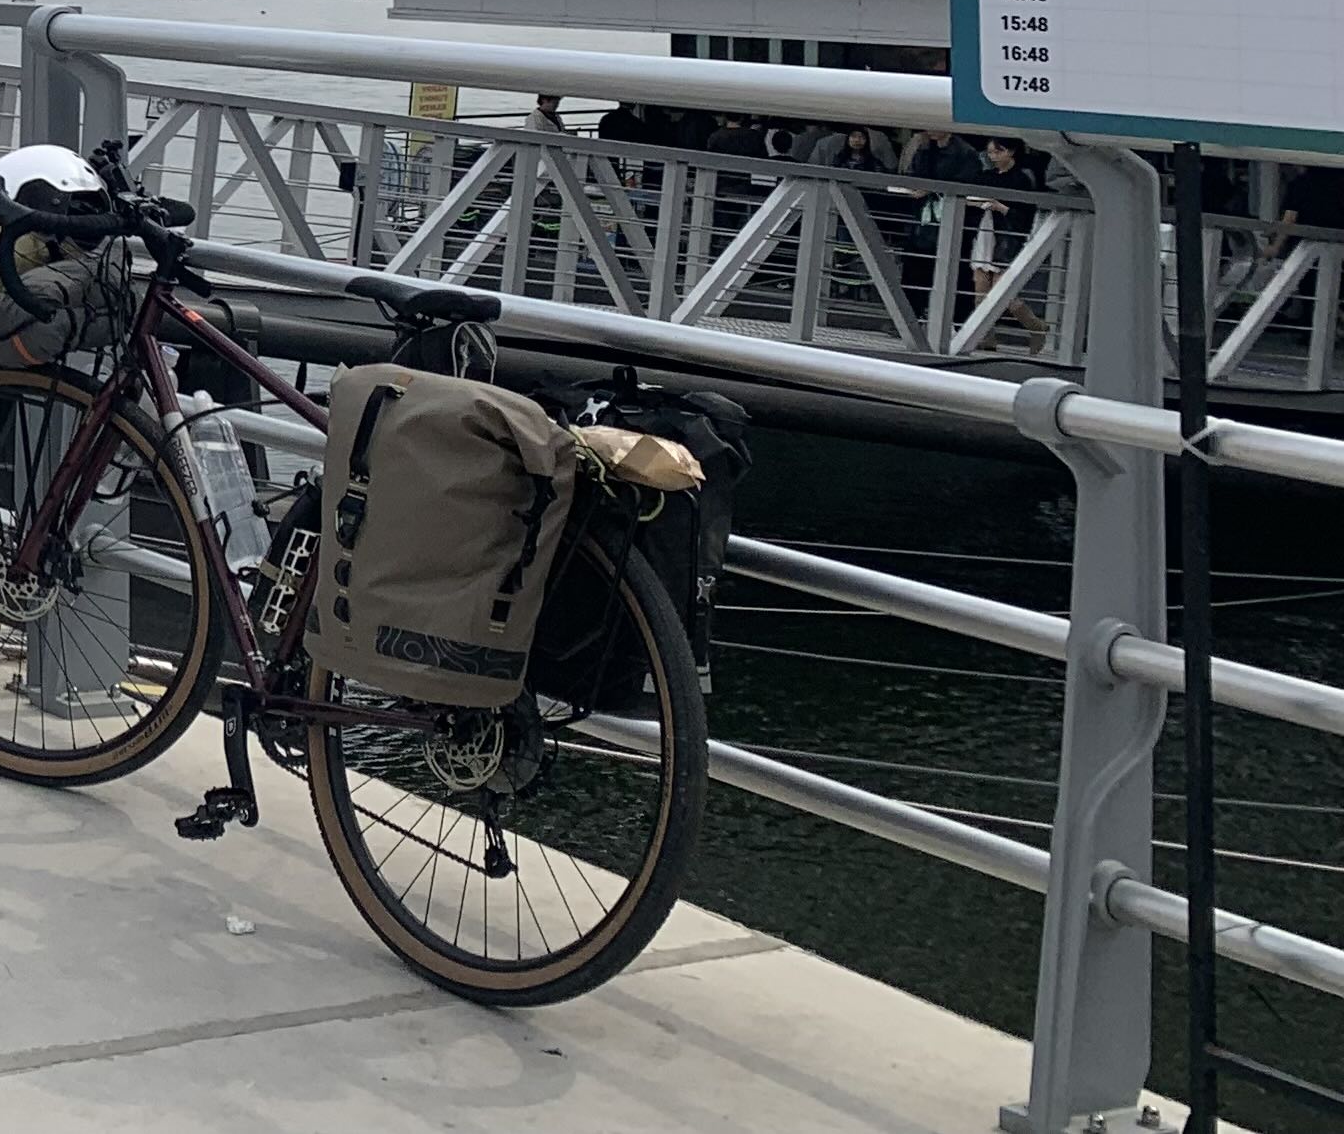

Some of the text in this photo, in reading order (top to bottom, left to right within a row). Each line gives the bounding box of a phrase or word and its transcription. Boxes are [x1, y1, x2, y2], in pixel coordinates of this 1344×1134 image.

[1001, 15, 1049, 32] 15:48
[1001, 46, 1049, 63] 16:48
[1002, 76, 1050, 92] 17:48
